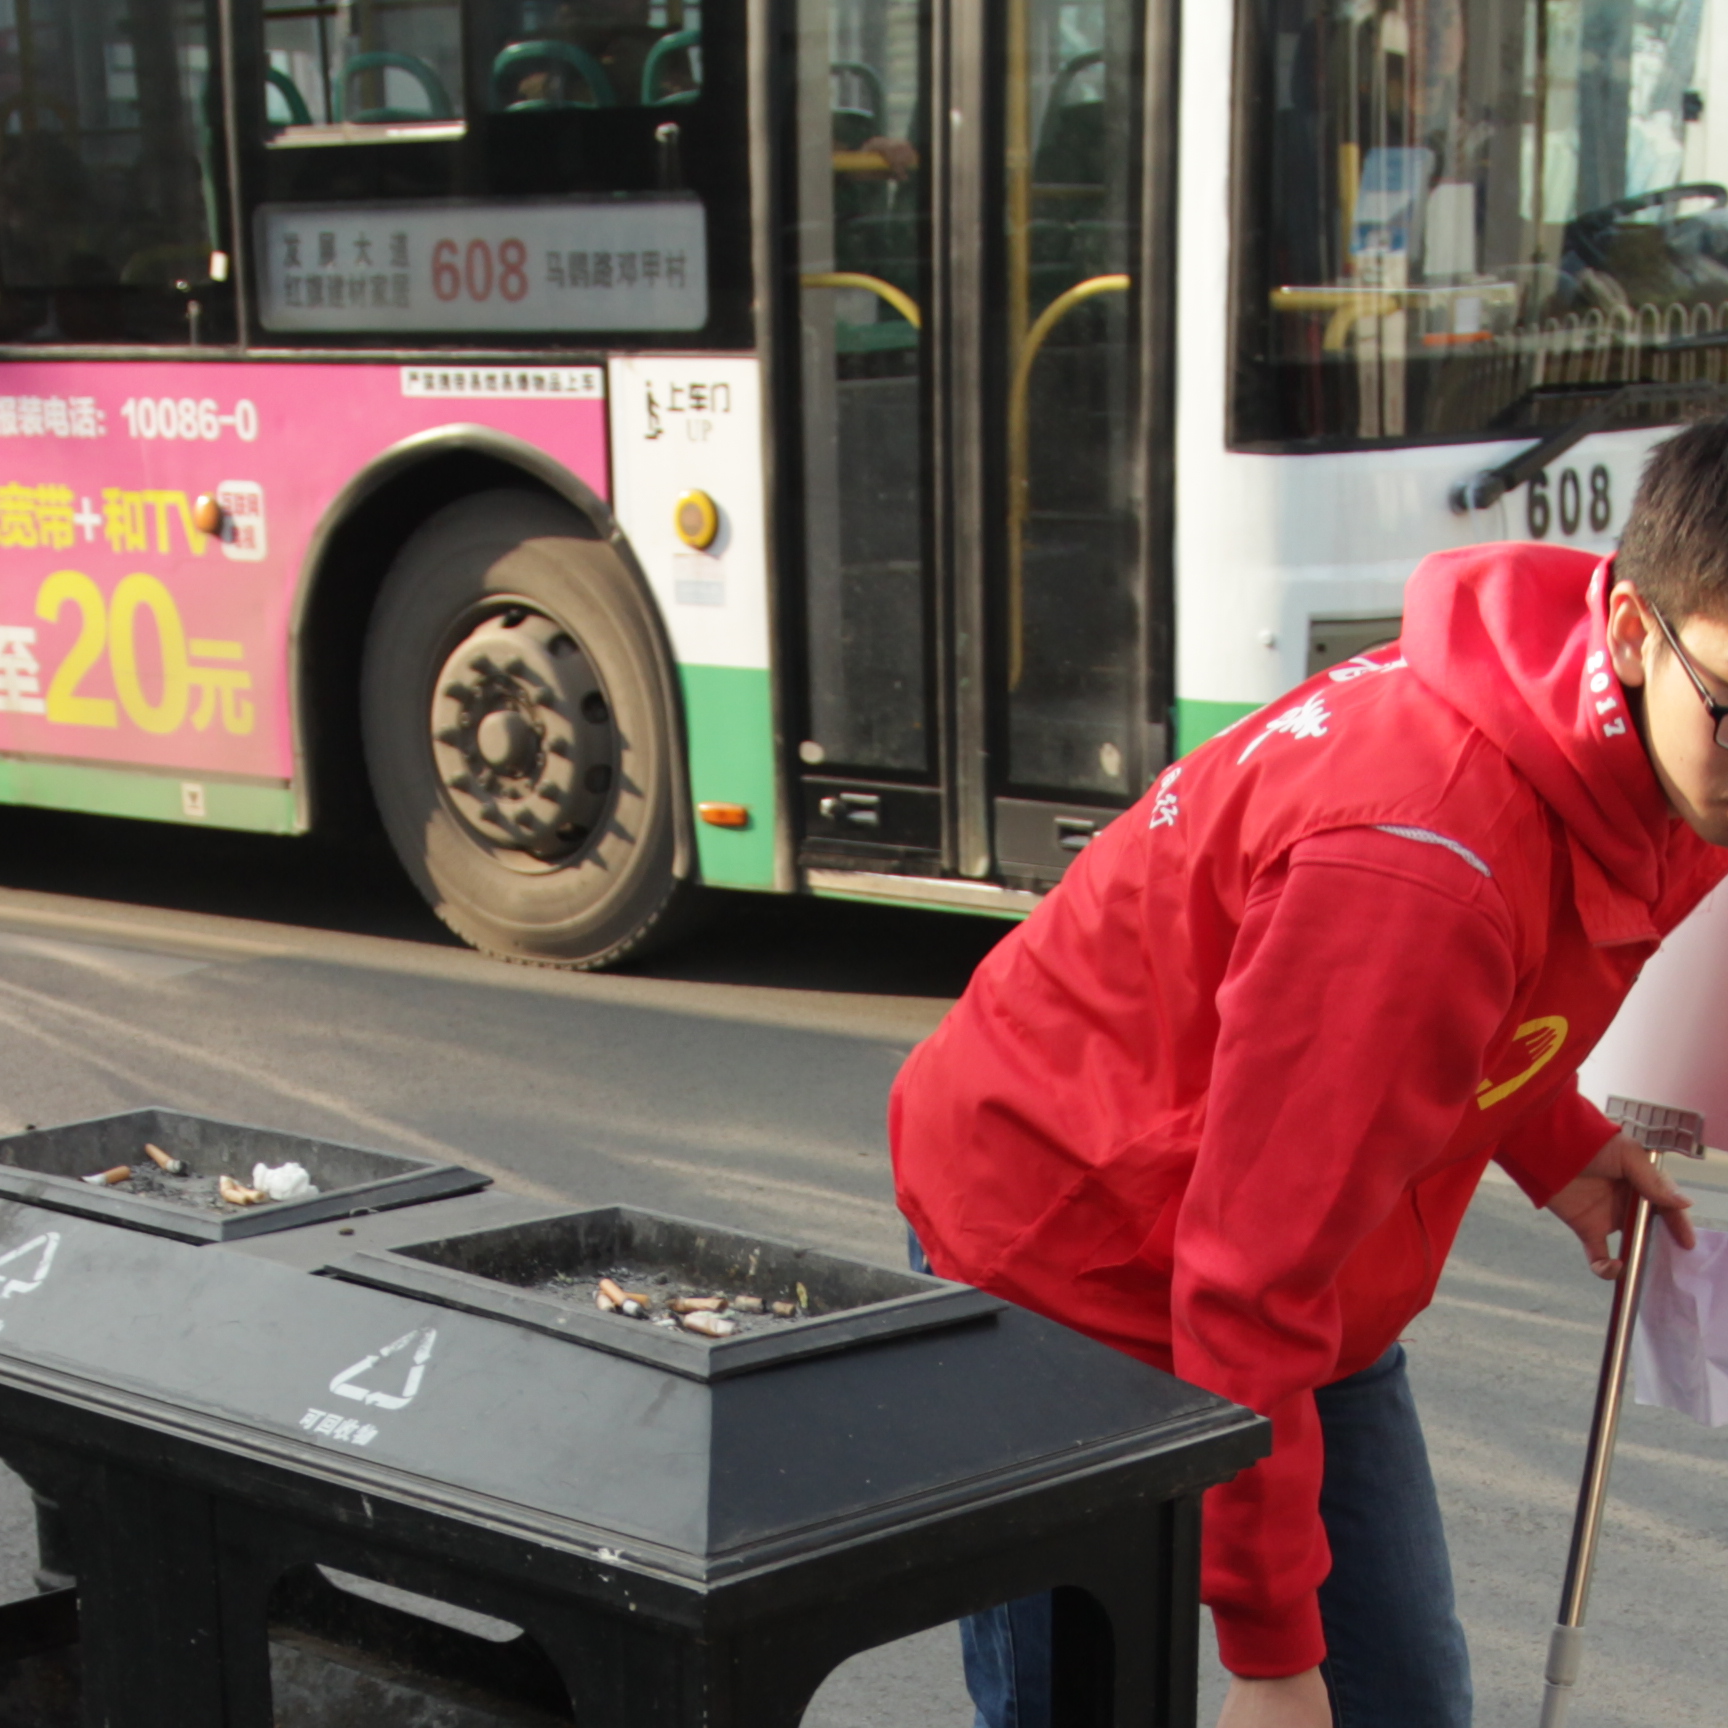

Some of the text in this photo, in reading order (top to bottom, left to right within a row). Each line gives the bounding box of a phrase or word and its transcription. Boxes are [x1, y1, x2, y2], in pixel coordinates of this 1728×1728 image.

[430, 236, 530, 303] 608
[120, 396, 259, 442] 10086-0
[666, 381, 732, 413] 上车门
[685, 419, 713, 442] UP
[1526, 464, 1612, 540] 608
[1586, 650, 1627, 739] 2017
[298, 1406, 380, 1447] 可回收物
